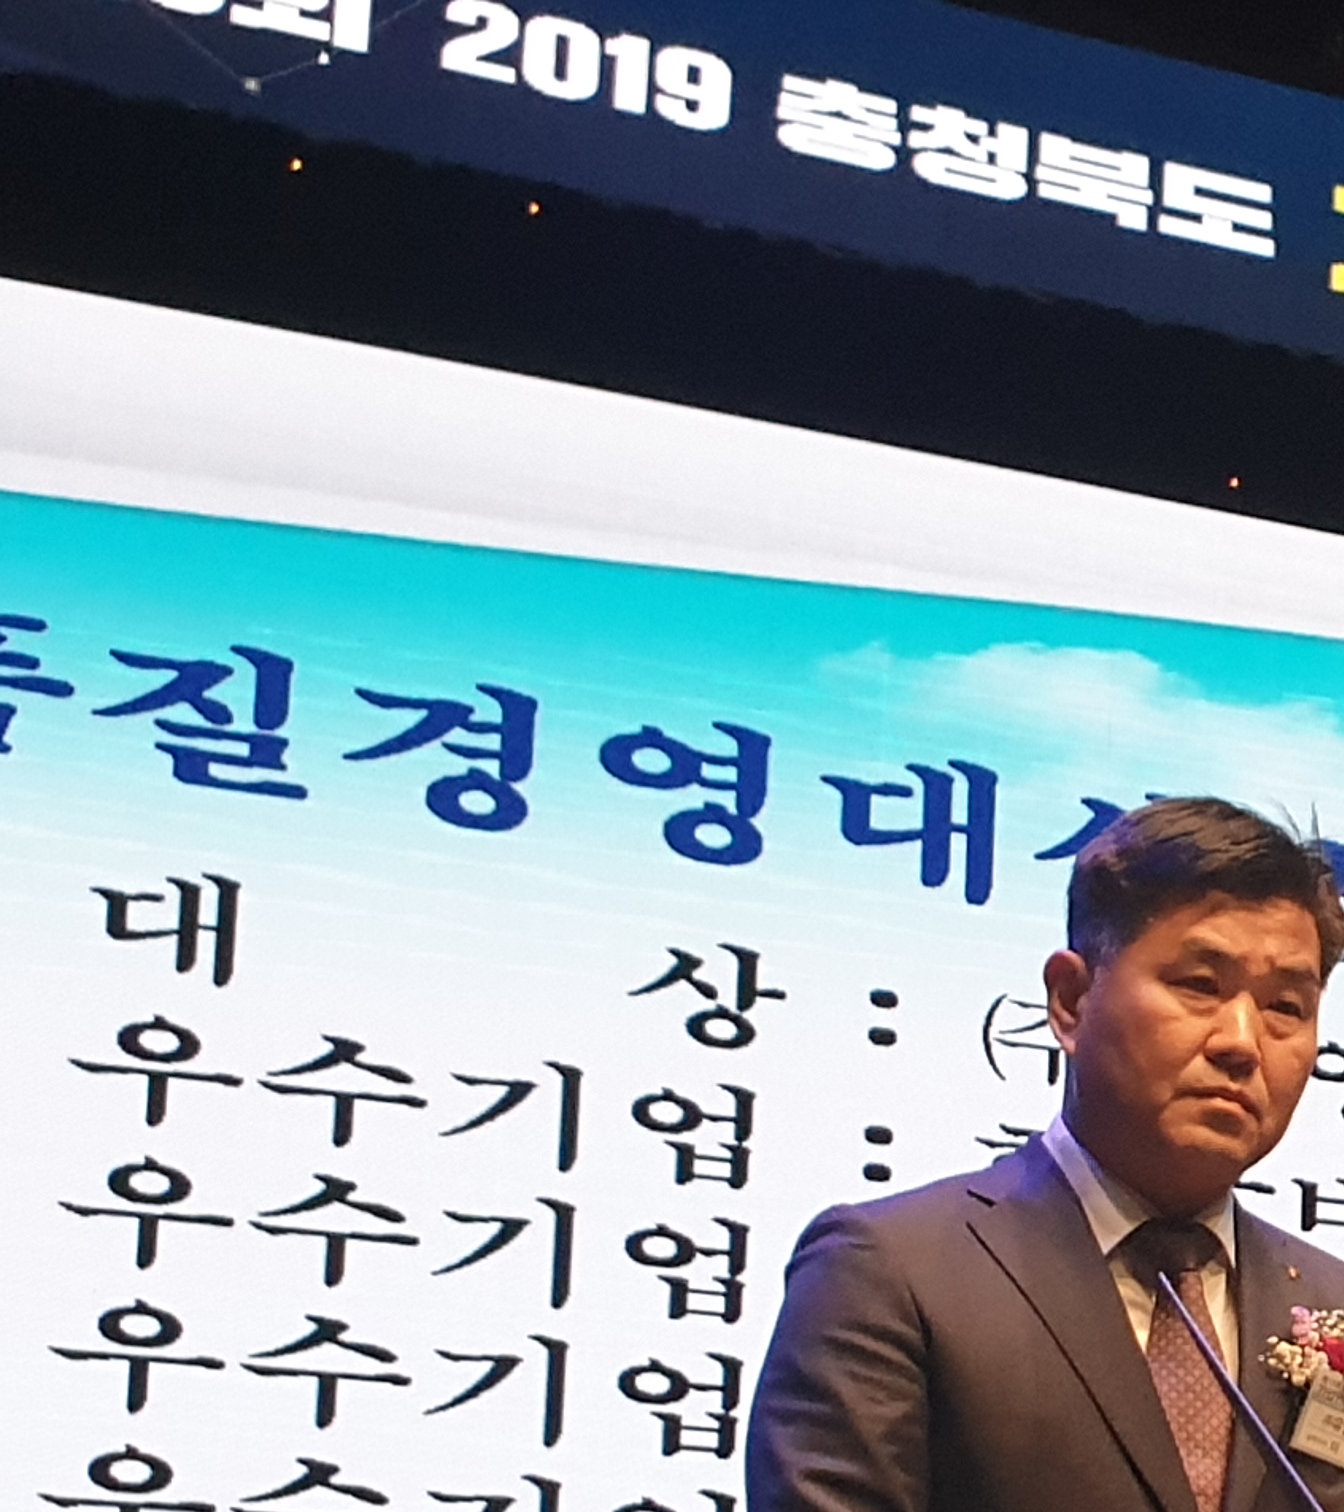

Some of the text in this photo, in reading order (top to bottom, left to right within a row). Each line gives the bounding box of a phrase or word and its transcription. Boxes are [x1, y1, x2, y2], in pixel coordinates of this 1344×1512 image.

[440, 0, 732, 131] 2019
[776, 74, 1275, 258] 충청북도
[91, 873, 241, 988] 대
[628, 943, 787, 1050] 상
[68, 1014, 756, 1190] 우수기업
[57, 1156, 750, 1325] 우수기업
[48, 1299, 744, 1460] 우수기업
